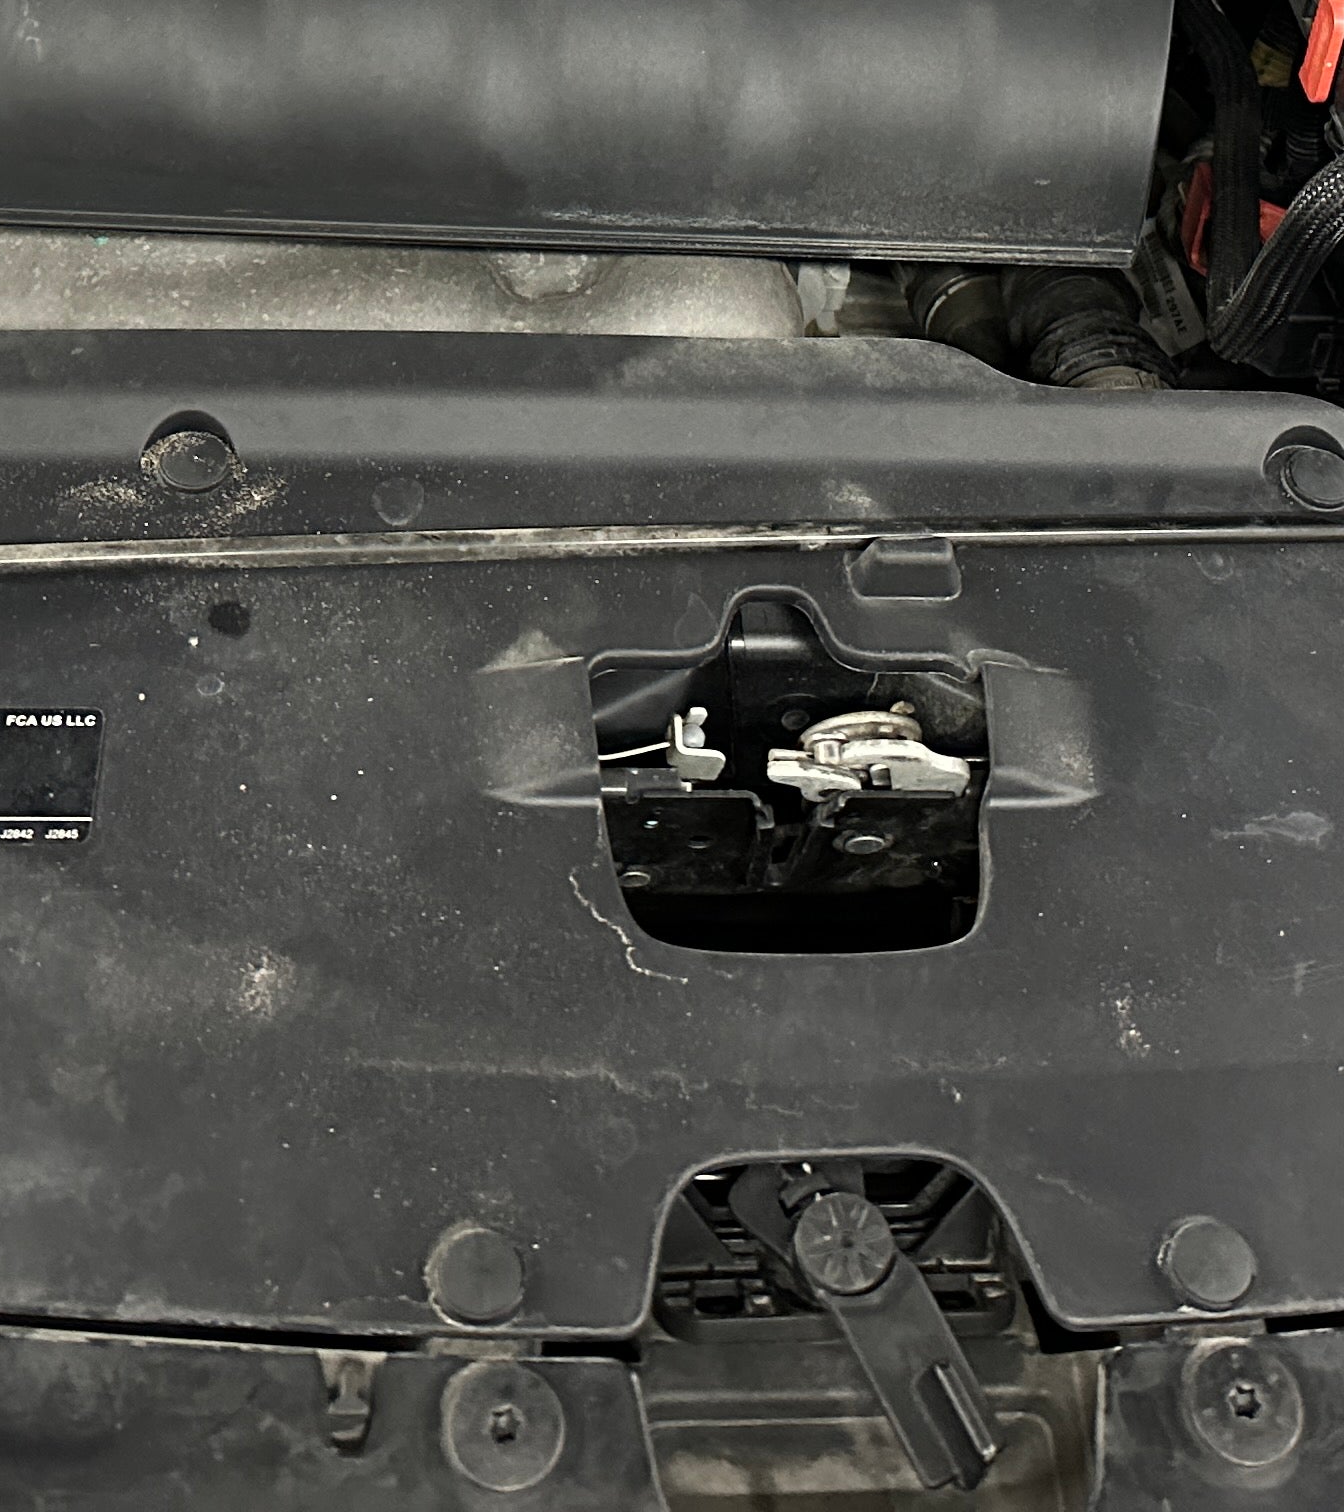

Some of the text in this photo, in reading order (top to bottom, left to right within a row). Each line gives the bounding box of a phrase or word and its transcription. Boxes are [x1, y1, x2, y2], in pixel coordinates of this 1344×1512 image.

[5, 713, 97, 727] FCA US LLC
